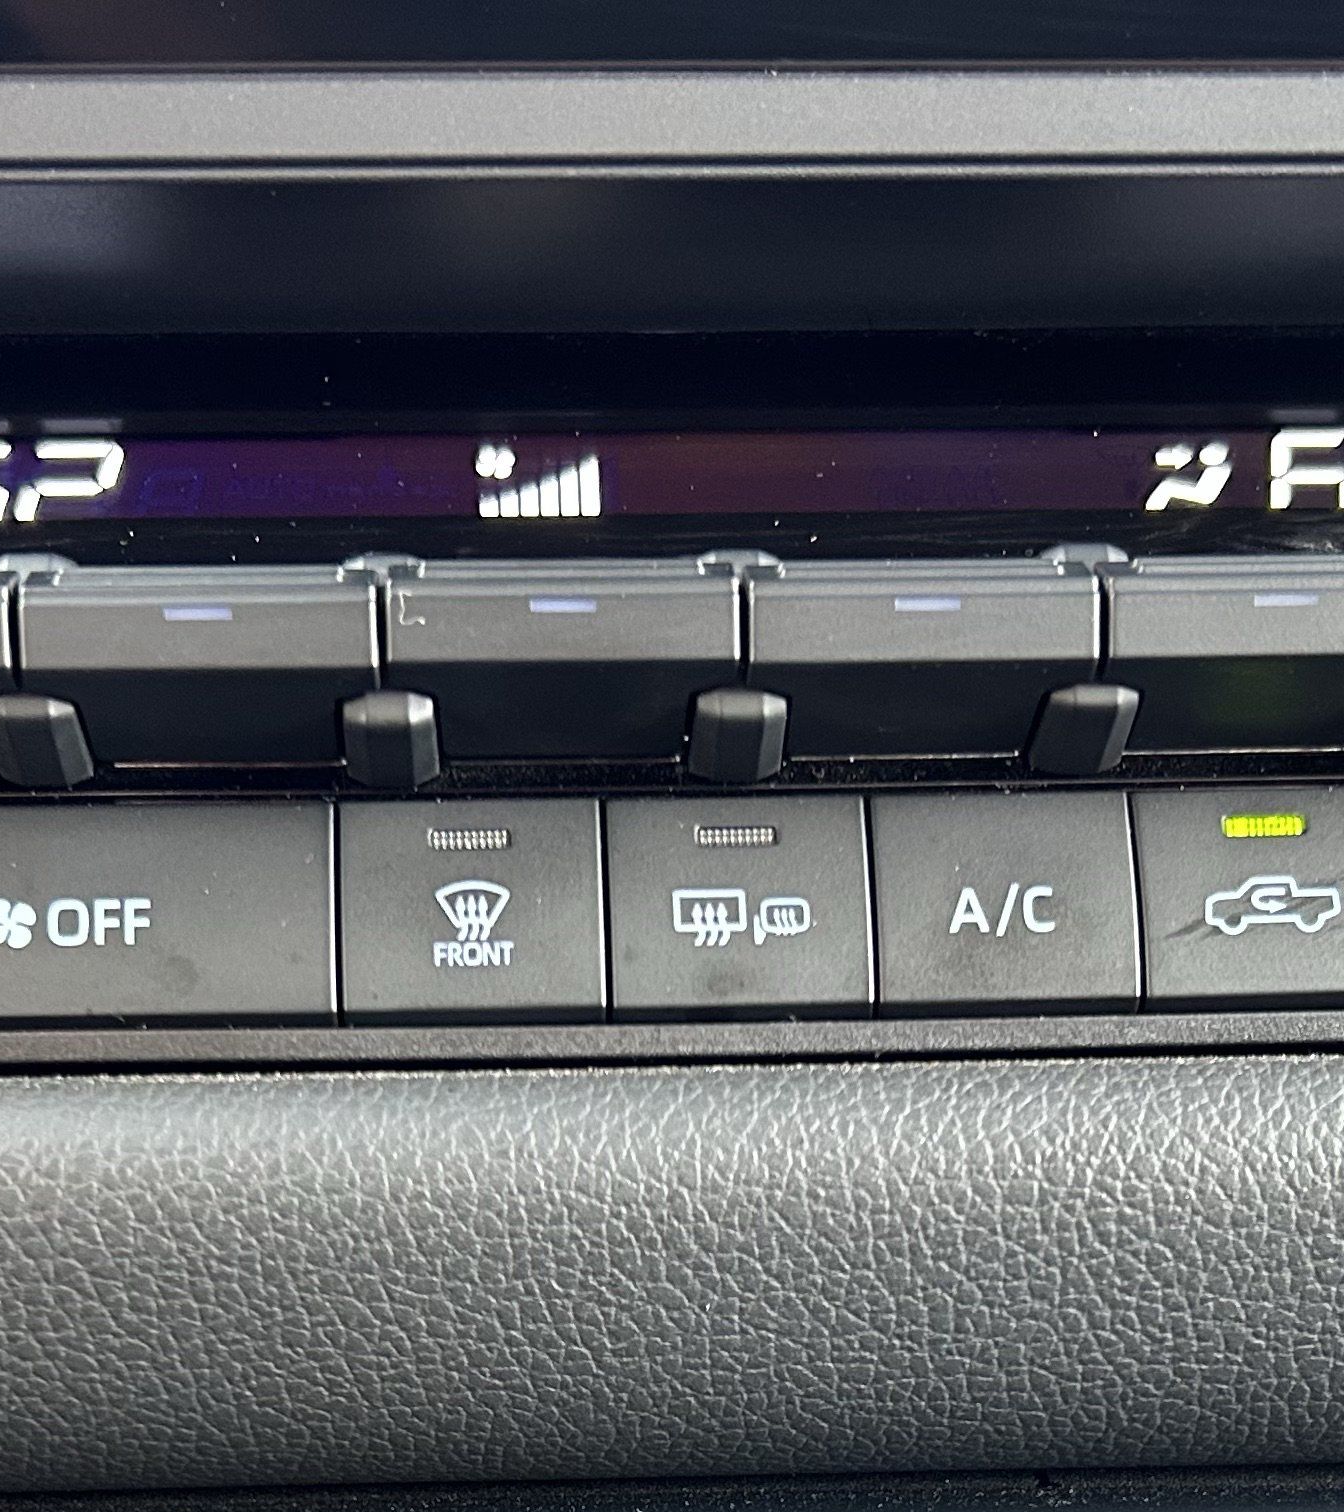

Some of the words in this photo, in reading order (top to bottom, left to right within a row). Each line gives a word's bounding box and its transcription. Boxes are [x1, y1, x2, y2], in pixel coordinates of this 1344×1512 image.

[47, 897, 151, 947] OFF
[949, 882, 1056, 937] A/C
[433, 940, 515, 968] FRONT
